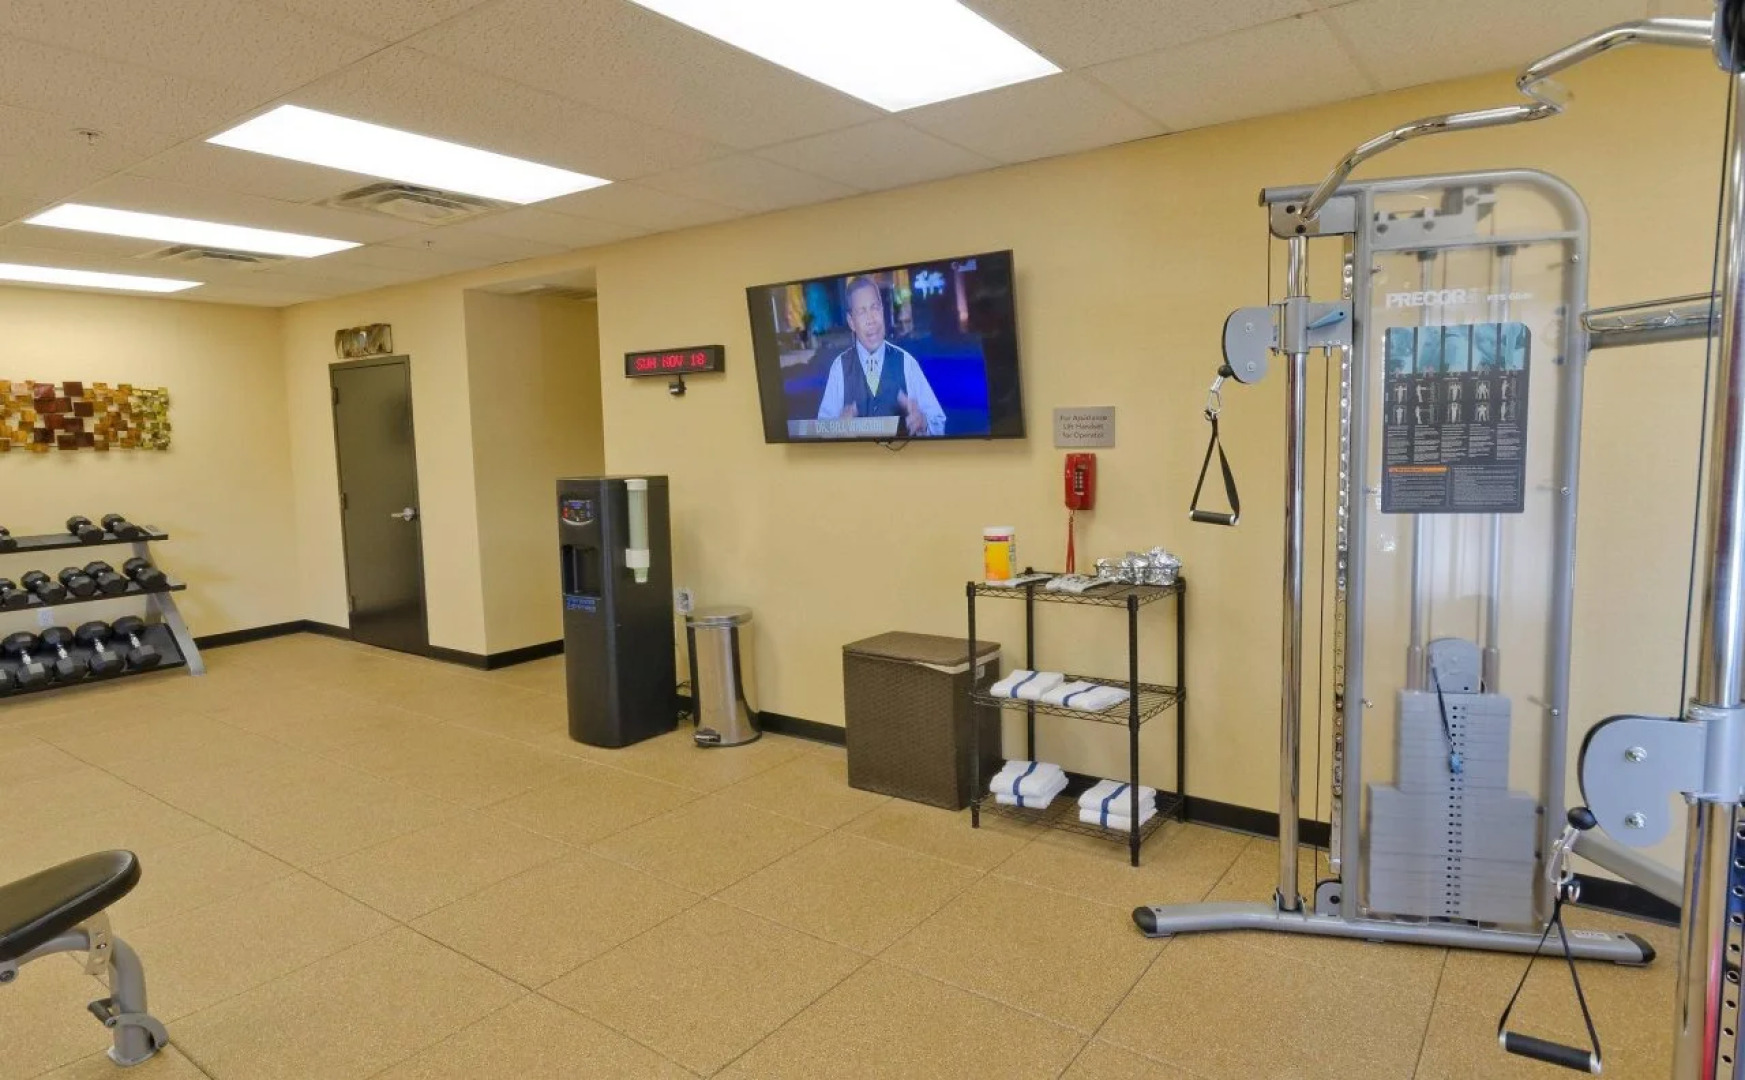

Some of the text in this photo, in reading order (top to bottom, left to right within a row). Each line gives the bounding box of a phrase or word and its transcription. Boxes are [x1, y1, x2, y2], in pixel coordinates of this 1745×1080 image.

[1386, 289, 1467, 308] PRECOR
[635, 351, 706, 371] SUN NOV 18
